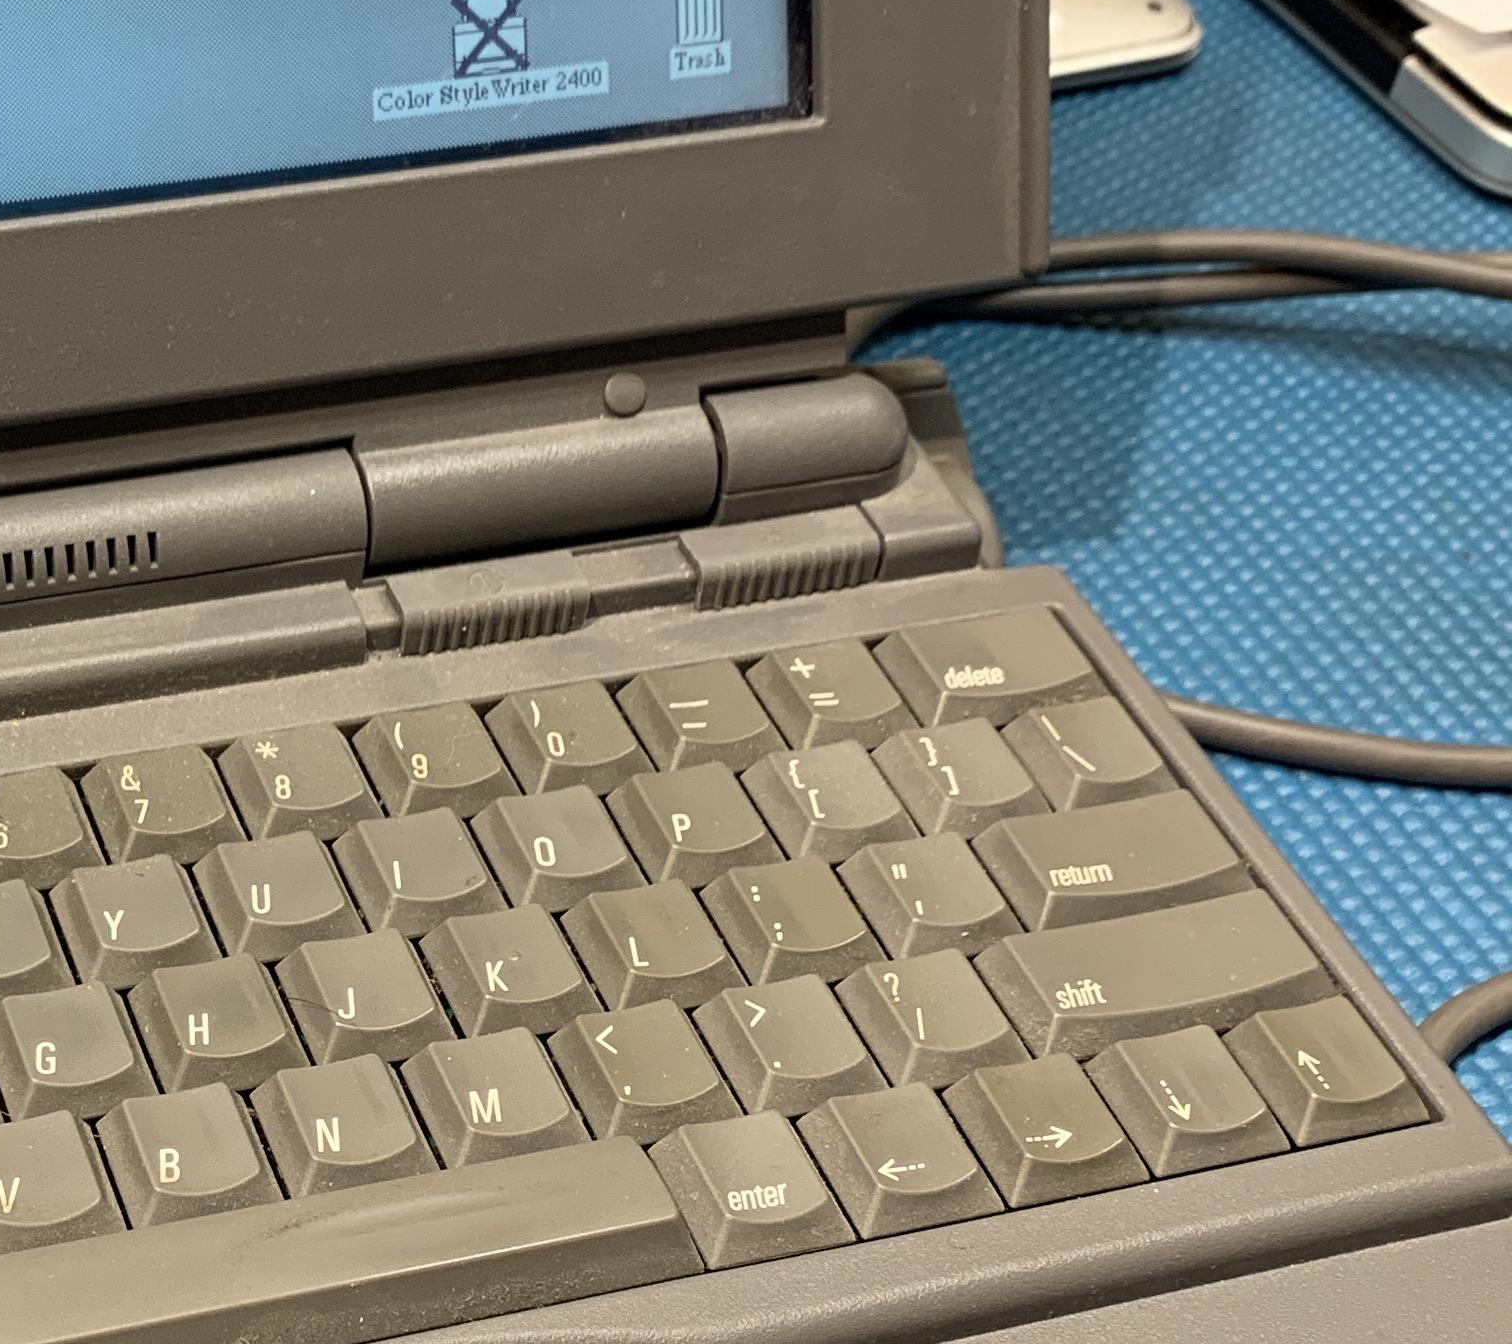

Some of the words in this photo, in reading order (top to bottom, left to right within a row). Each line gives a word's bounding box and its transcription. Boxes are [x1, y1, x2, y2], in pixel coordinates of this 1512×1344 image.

[674, 47, 727, 72] Trash
[377, 87, 433, 113] Color
[555, 66, 602, 92] 2400
[943, 663, 1006, 690] delete
[546, 731, 565, 757] 0
[121, 765, 141, 792] &
[410, 753, 429, 779] 9
[274, 774, 292, 800] 8
[134, 799, 149, 824] 7
[671, 812, 692, 842] P
[534, 836, 556, 867] O
[1049, 863, 1114, 888] return
[250, 883, 272, 914] U
[103, 909, 125, 941] Y
[628, 936, 649, 967] L
[485, 960, 510, 993] K
[337, 986, 356, 1020] J
[1055, 978, 1108, 1011] shift
[188, 1012, 210, 1046] H
[35, 1041, 58, 1076] G
[468, 1088, 503, 1124] M
[315, 1116, 341, 1153] N
[159, 1148, 181, 1184] B
[727, 1182, 788, 1212] enter
